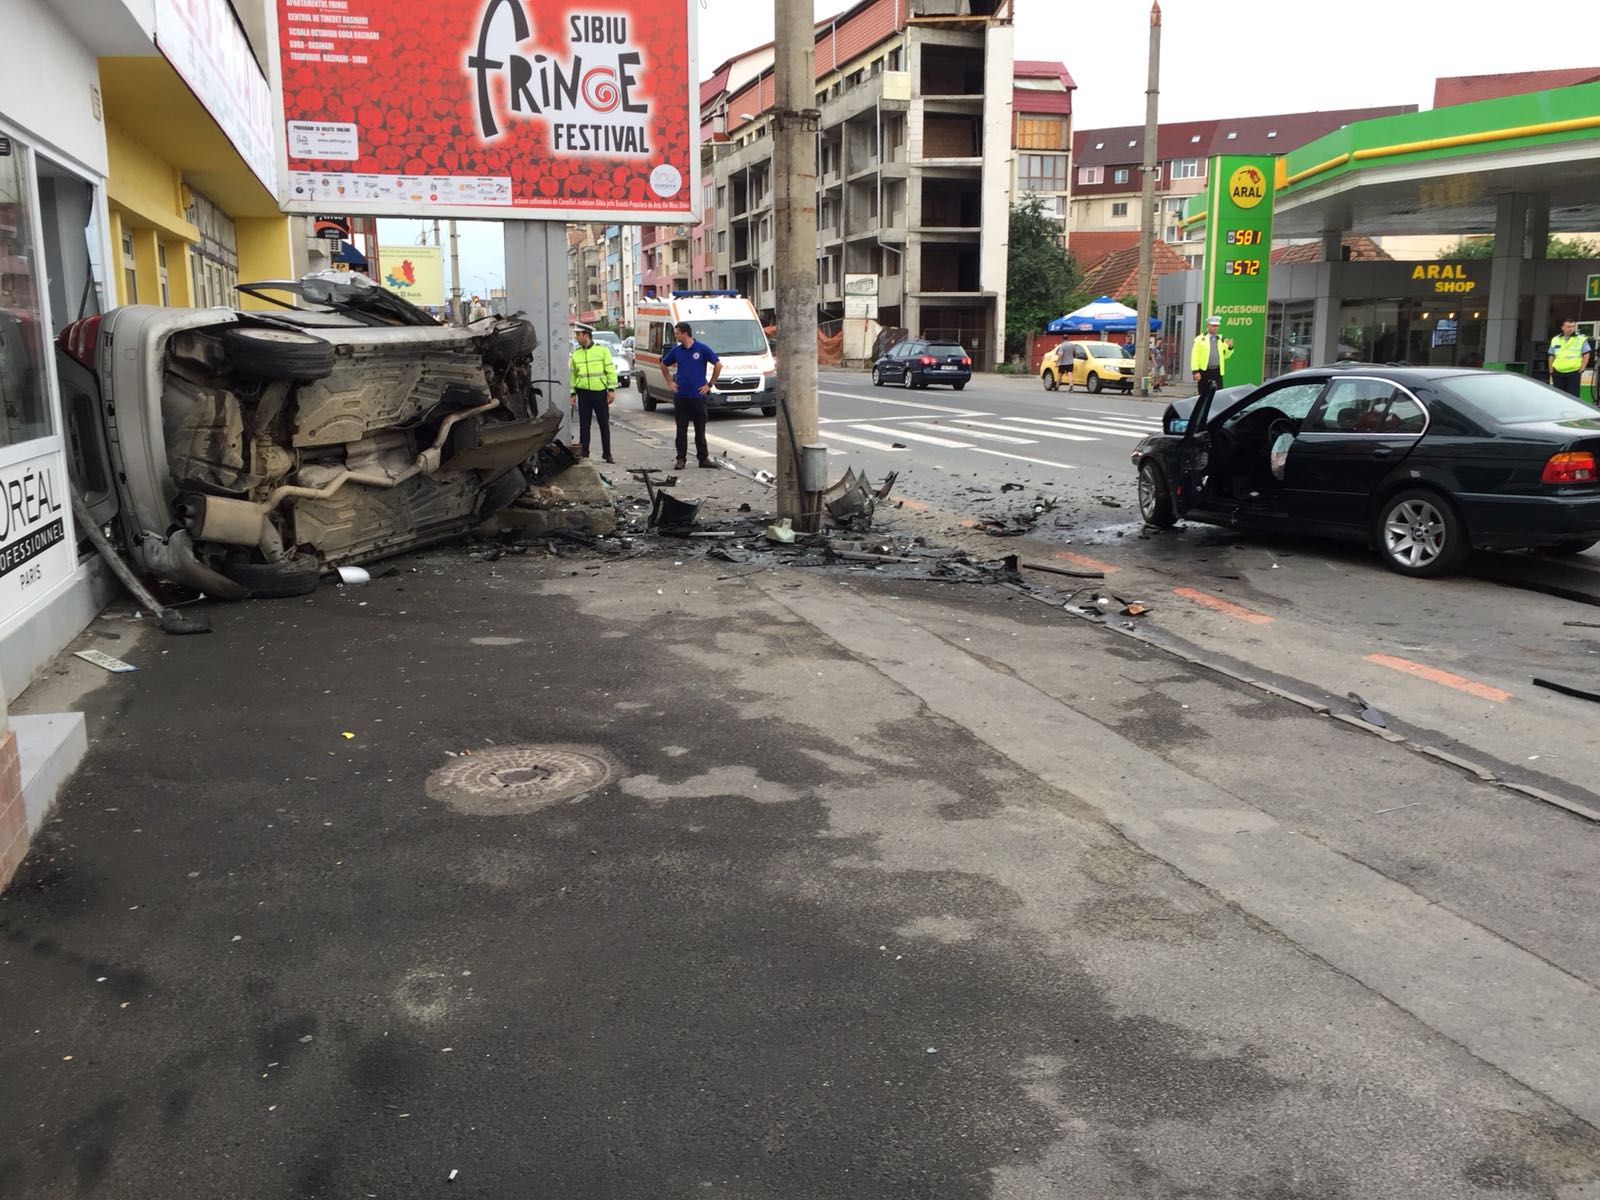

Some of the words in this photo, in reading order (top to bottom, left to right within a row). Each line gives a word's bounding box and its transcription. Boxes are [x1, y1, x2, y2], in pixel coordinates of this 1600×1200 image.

[571, 15, 626, 44] SIBIU
[554, 123, 649, 153] FESTIVAL
[1232, 186, 1262, 198] ARAL
[1236, 230, 1262, 245] 581
[1234, 260, 1260, 275] 572
[1412, 264, 1467, 279] ARAL
[1435, 281, 1475, 292] SHOP
[1214, 304, 1266, 314] ACCESORII
[1227, 317, 1253, 326] AUTO
[20, 564, 42, 590] PARIS
